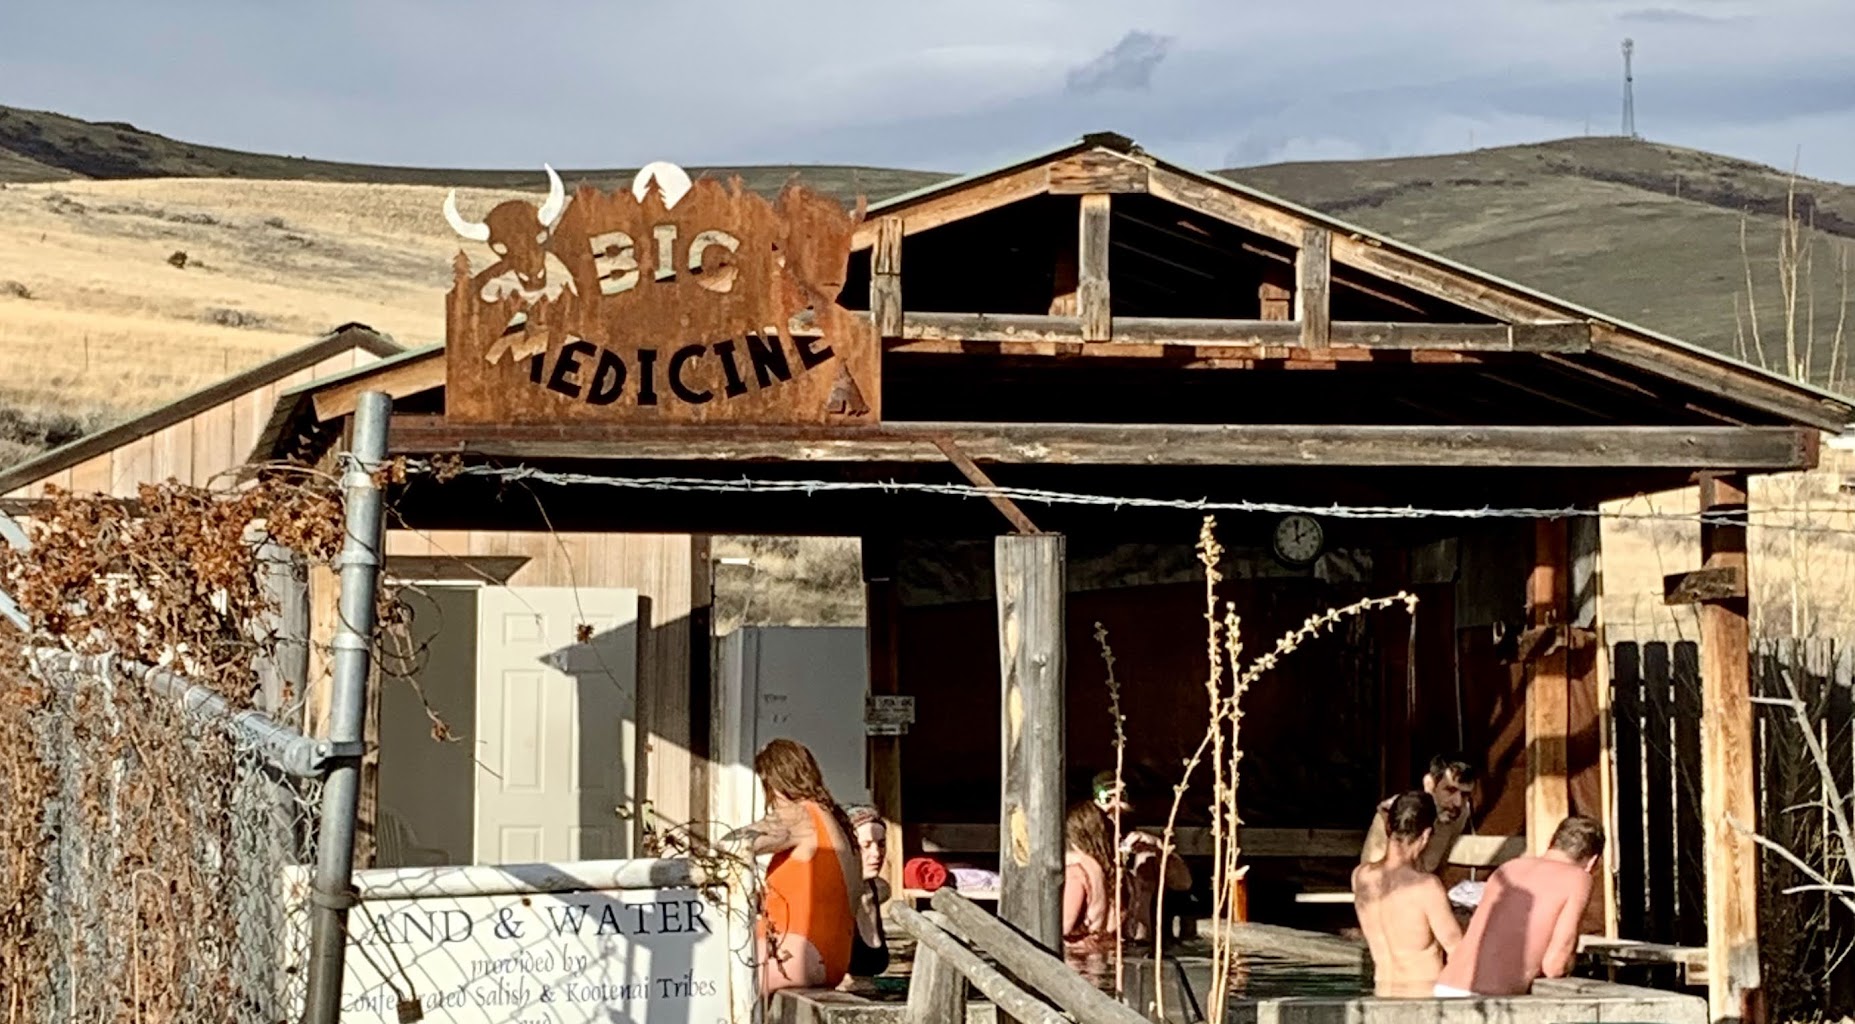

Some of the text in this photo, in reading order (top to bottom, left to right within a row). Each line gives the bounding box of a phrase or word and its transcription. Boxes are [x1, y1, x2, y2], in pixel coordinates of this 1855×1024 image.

[589, 224, 740, 295] BIG
[485, 311, 835, 406] MEDICINE
[494, 907, 526, 940] &
[545, 900, 713, 937] WATER
[471, 943, 588, 983] provided by
[475, 975, 531, 1008] Salish
[540, 984, 556, 1003] &
[567, 976, 649, 1003] Kootenai
[657, 968, 717, 999] Tribes
